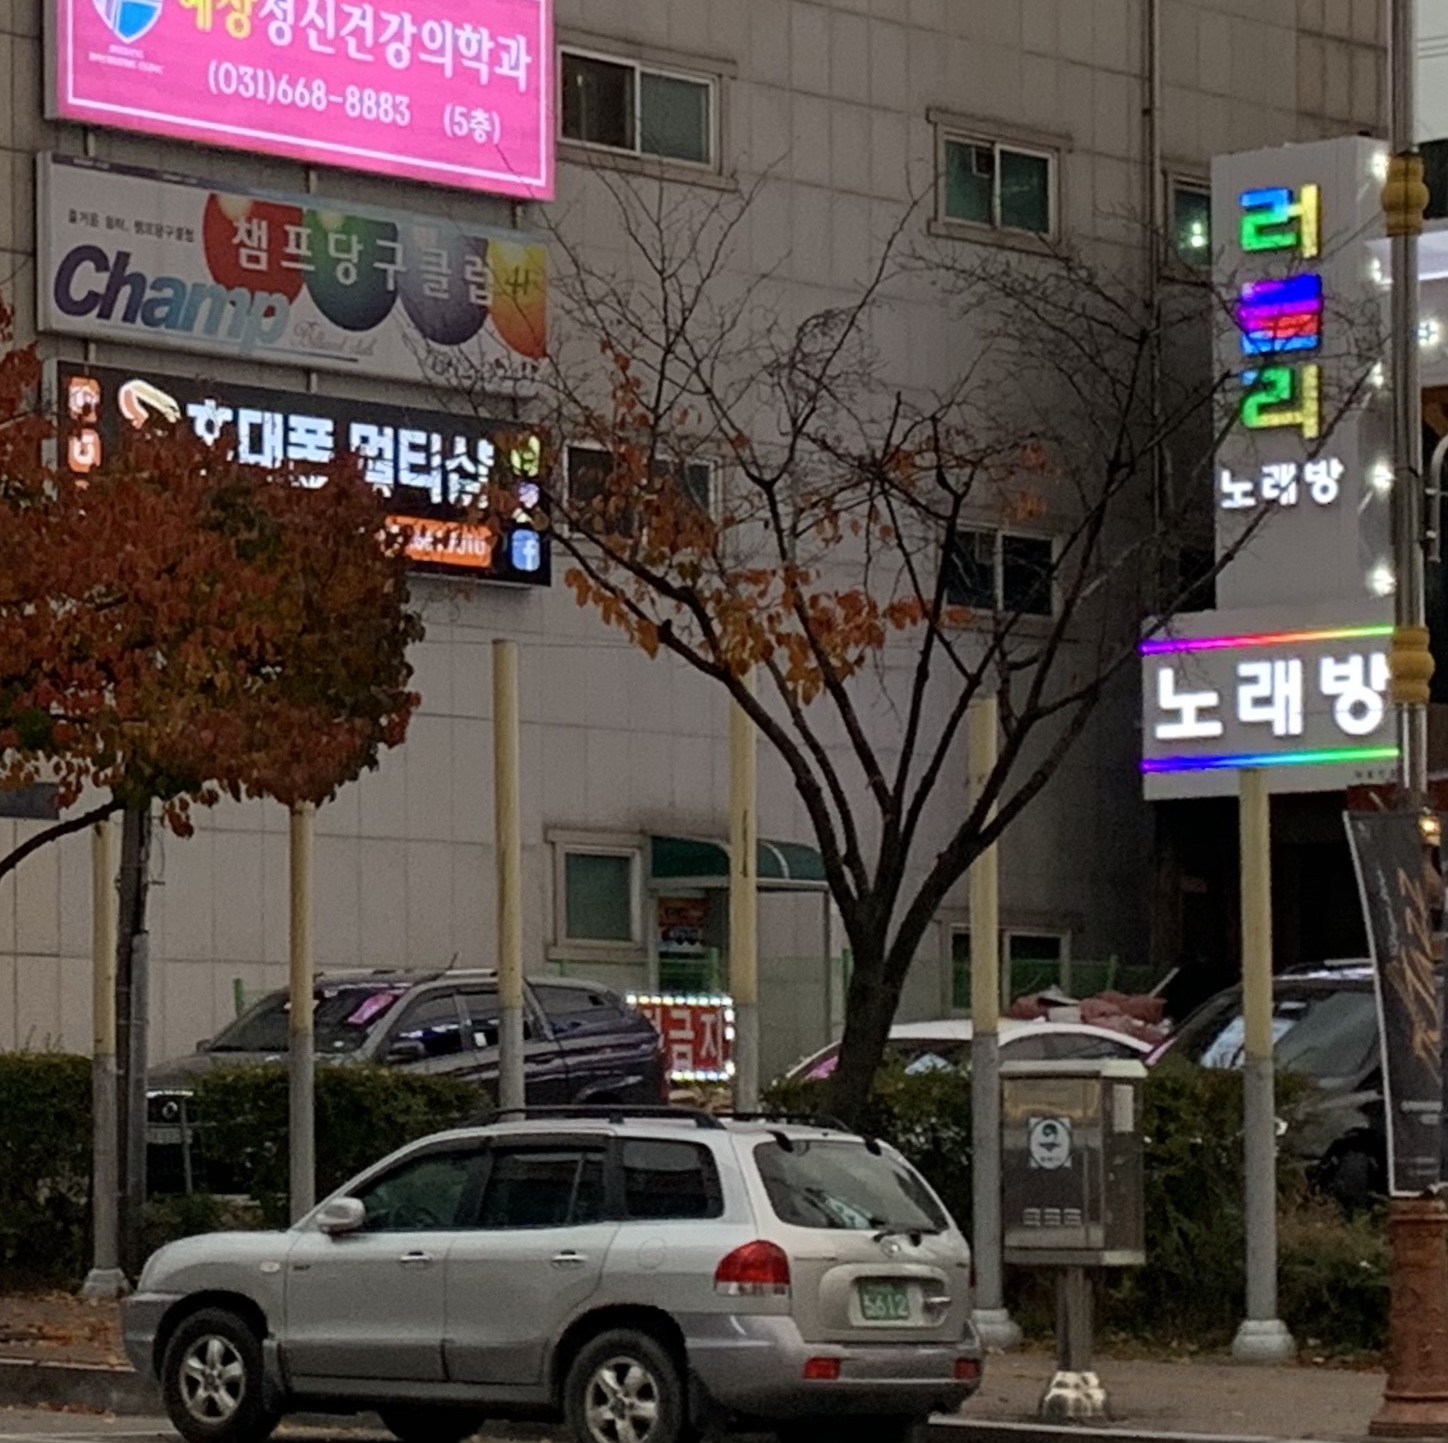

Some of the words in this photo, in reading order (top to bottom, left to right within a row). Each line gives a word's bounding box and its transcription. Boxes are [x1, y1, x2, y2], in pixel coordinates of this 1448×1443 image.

[208, 60, 412, 127] (031)668-8883
[443, 103, 501, 145] (5층)
[53, 243, 290, 356] Champ
[233, 217, 493, 307] 챔프당구클럽
[350, 423, 495, 509] 멀티샵
[1219, 458, 1345, 509] 노래방
[1155, 652, 1391, 740] 노래방
